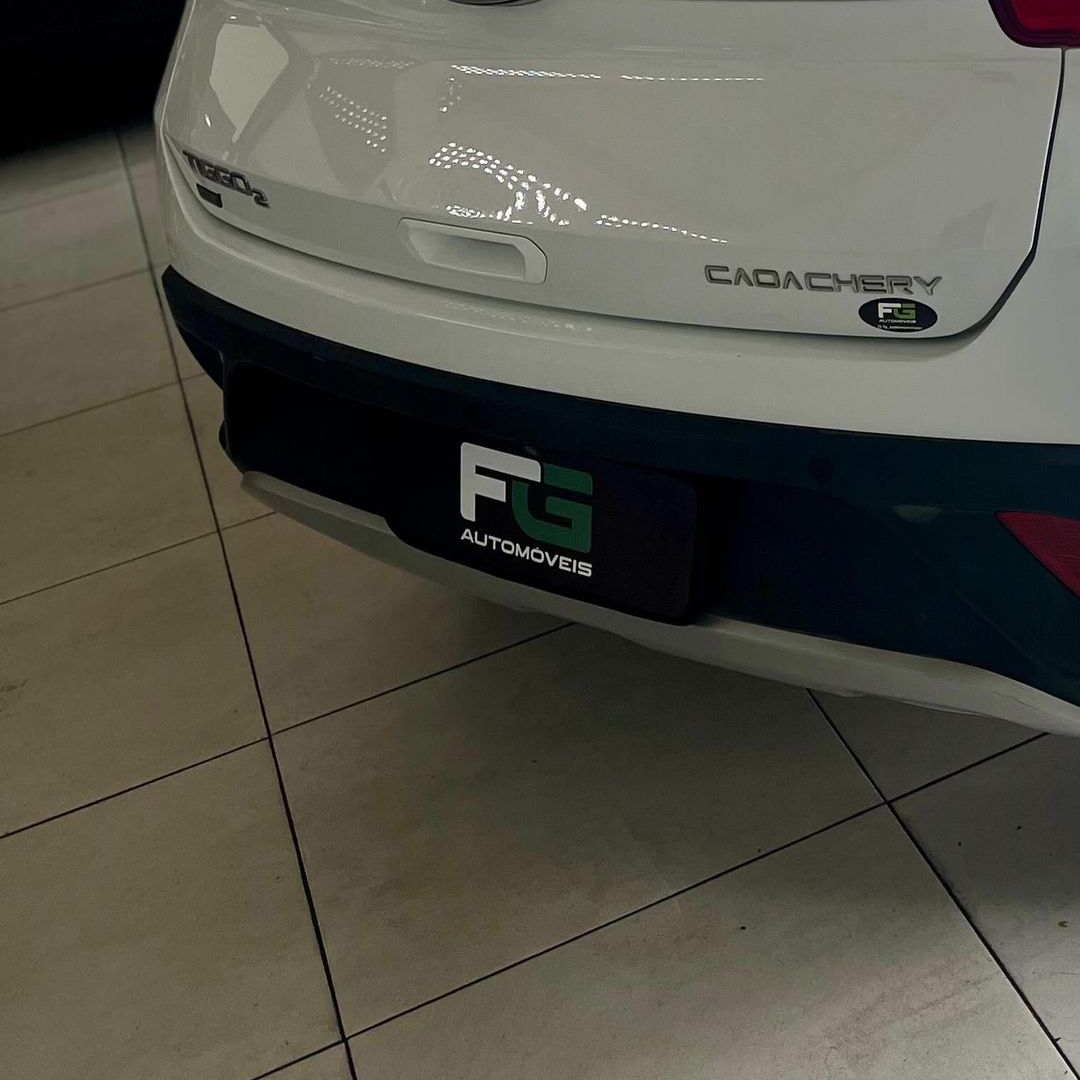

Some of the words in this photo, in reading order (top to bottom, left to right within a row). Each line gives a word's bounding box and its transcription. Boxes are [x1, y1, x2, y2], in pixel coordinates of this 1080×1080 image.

[877, 302, 916, 320] FG
[460, 441, 593, 553] FG
[460, 528, 593, 577] AUTOMÓVEIS
